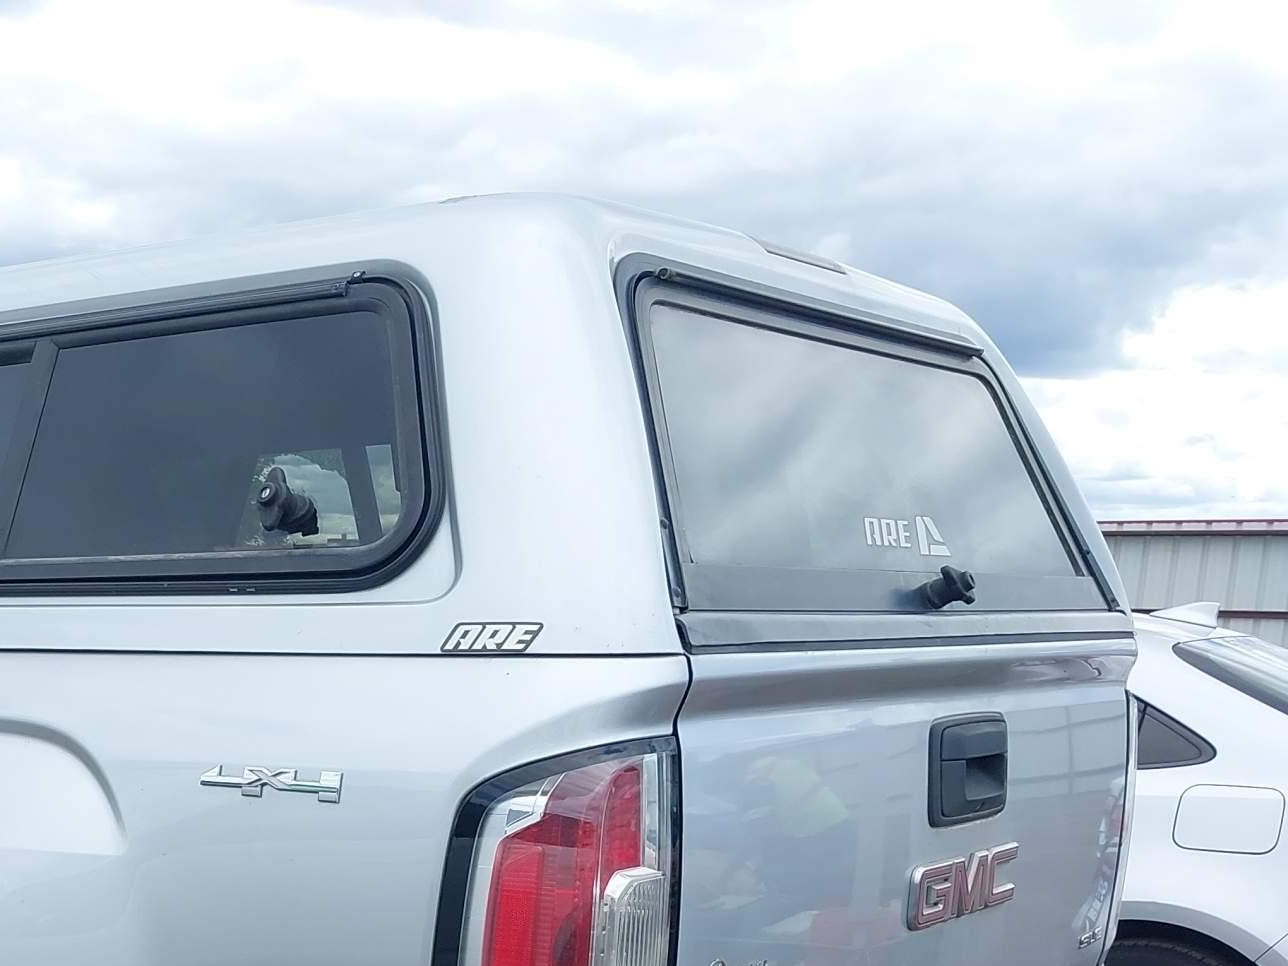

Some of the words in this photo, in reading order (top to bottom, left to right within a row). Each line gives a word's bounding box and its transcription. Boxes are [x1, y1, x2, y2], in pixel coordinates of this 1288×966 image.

[863, 516, 912, 548] ARE
[440, 622, 544, 653] ARE
[906, 841, 1020, 932] GMC
